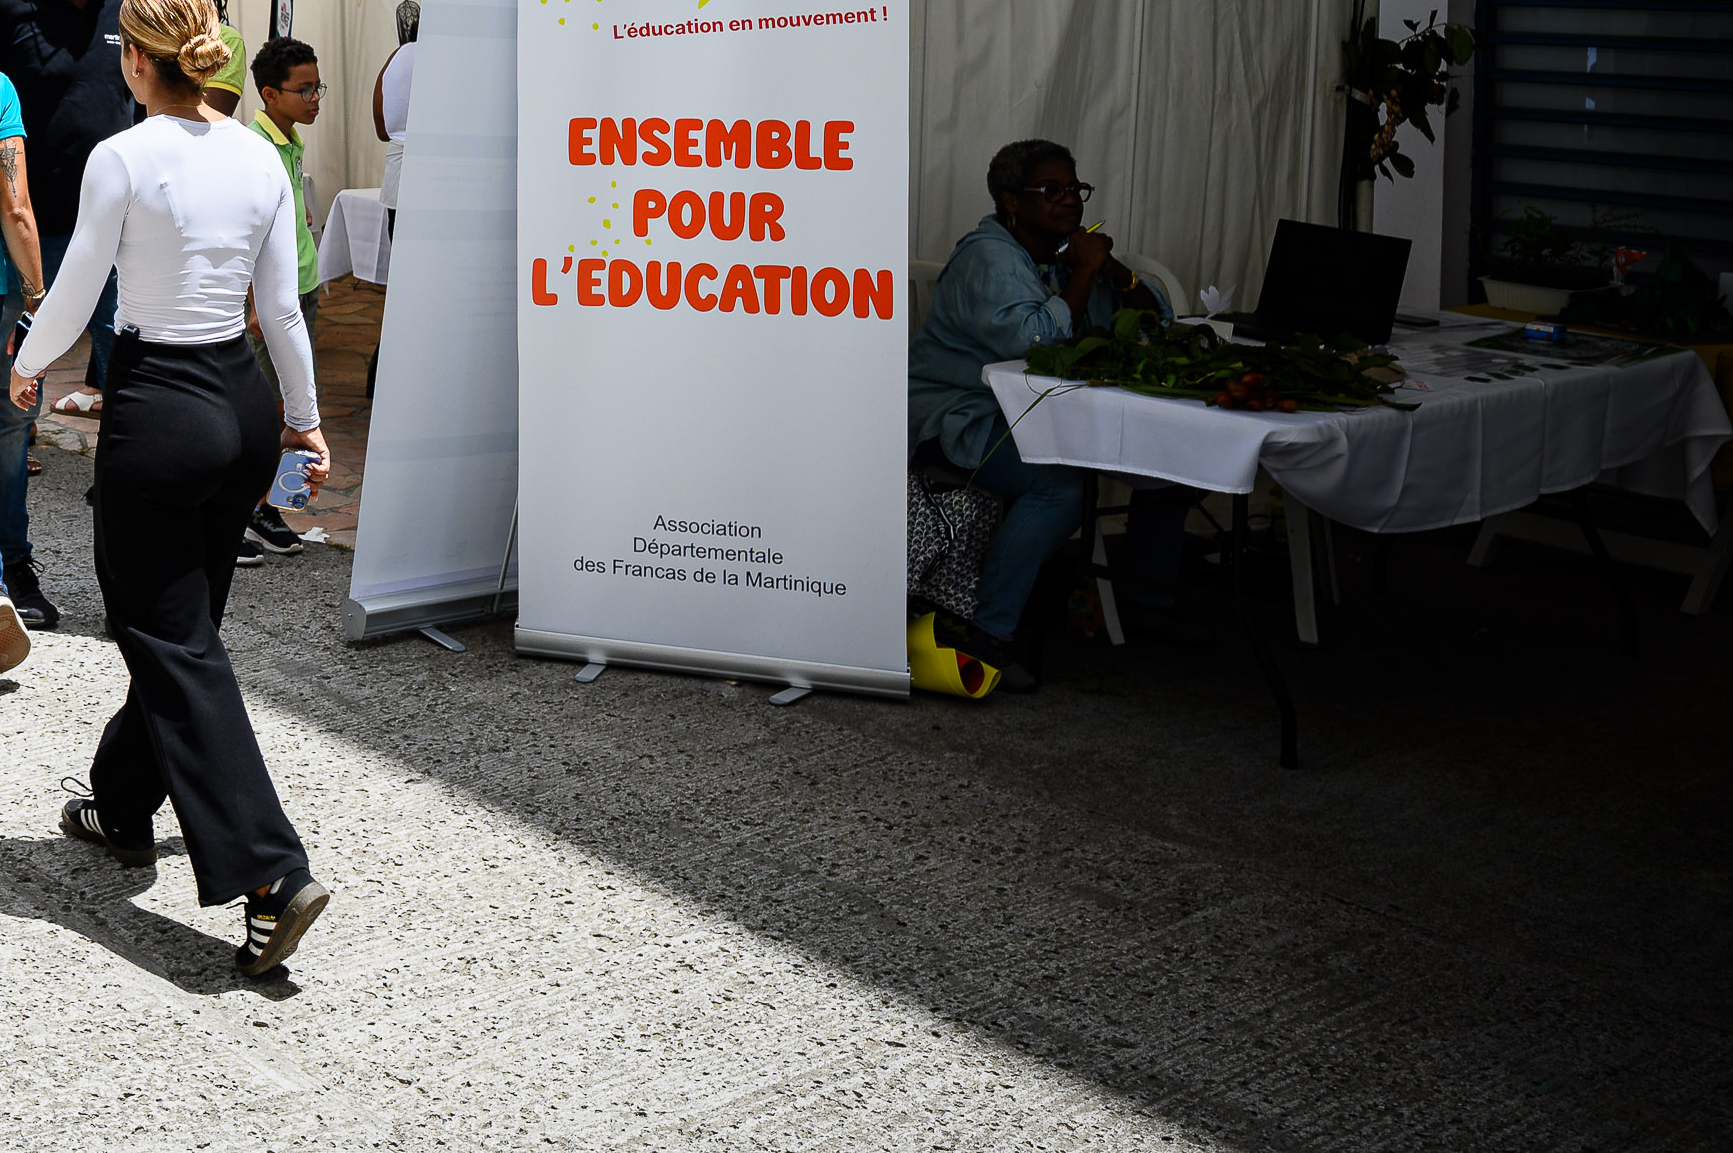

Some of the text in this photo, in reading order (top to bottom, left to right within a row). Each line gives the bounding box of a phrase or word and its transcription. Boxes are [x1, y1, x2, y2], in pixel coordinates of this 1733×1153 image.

[613, 6, 888, 40] L'éducation en mouvement !
[568, 117, 855, 171] ENSEMBLE
[633, 188, 786, 242] POUR
[531, 256, 894, 320] L'EDUCATION
[653, 515, 762, 539] Association
[633, 537, 784, 565] Départementale
[573, 556, 847, 598] des Francas de la Martinique
